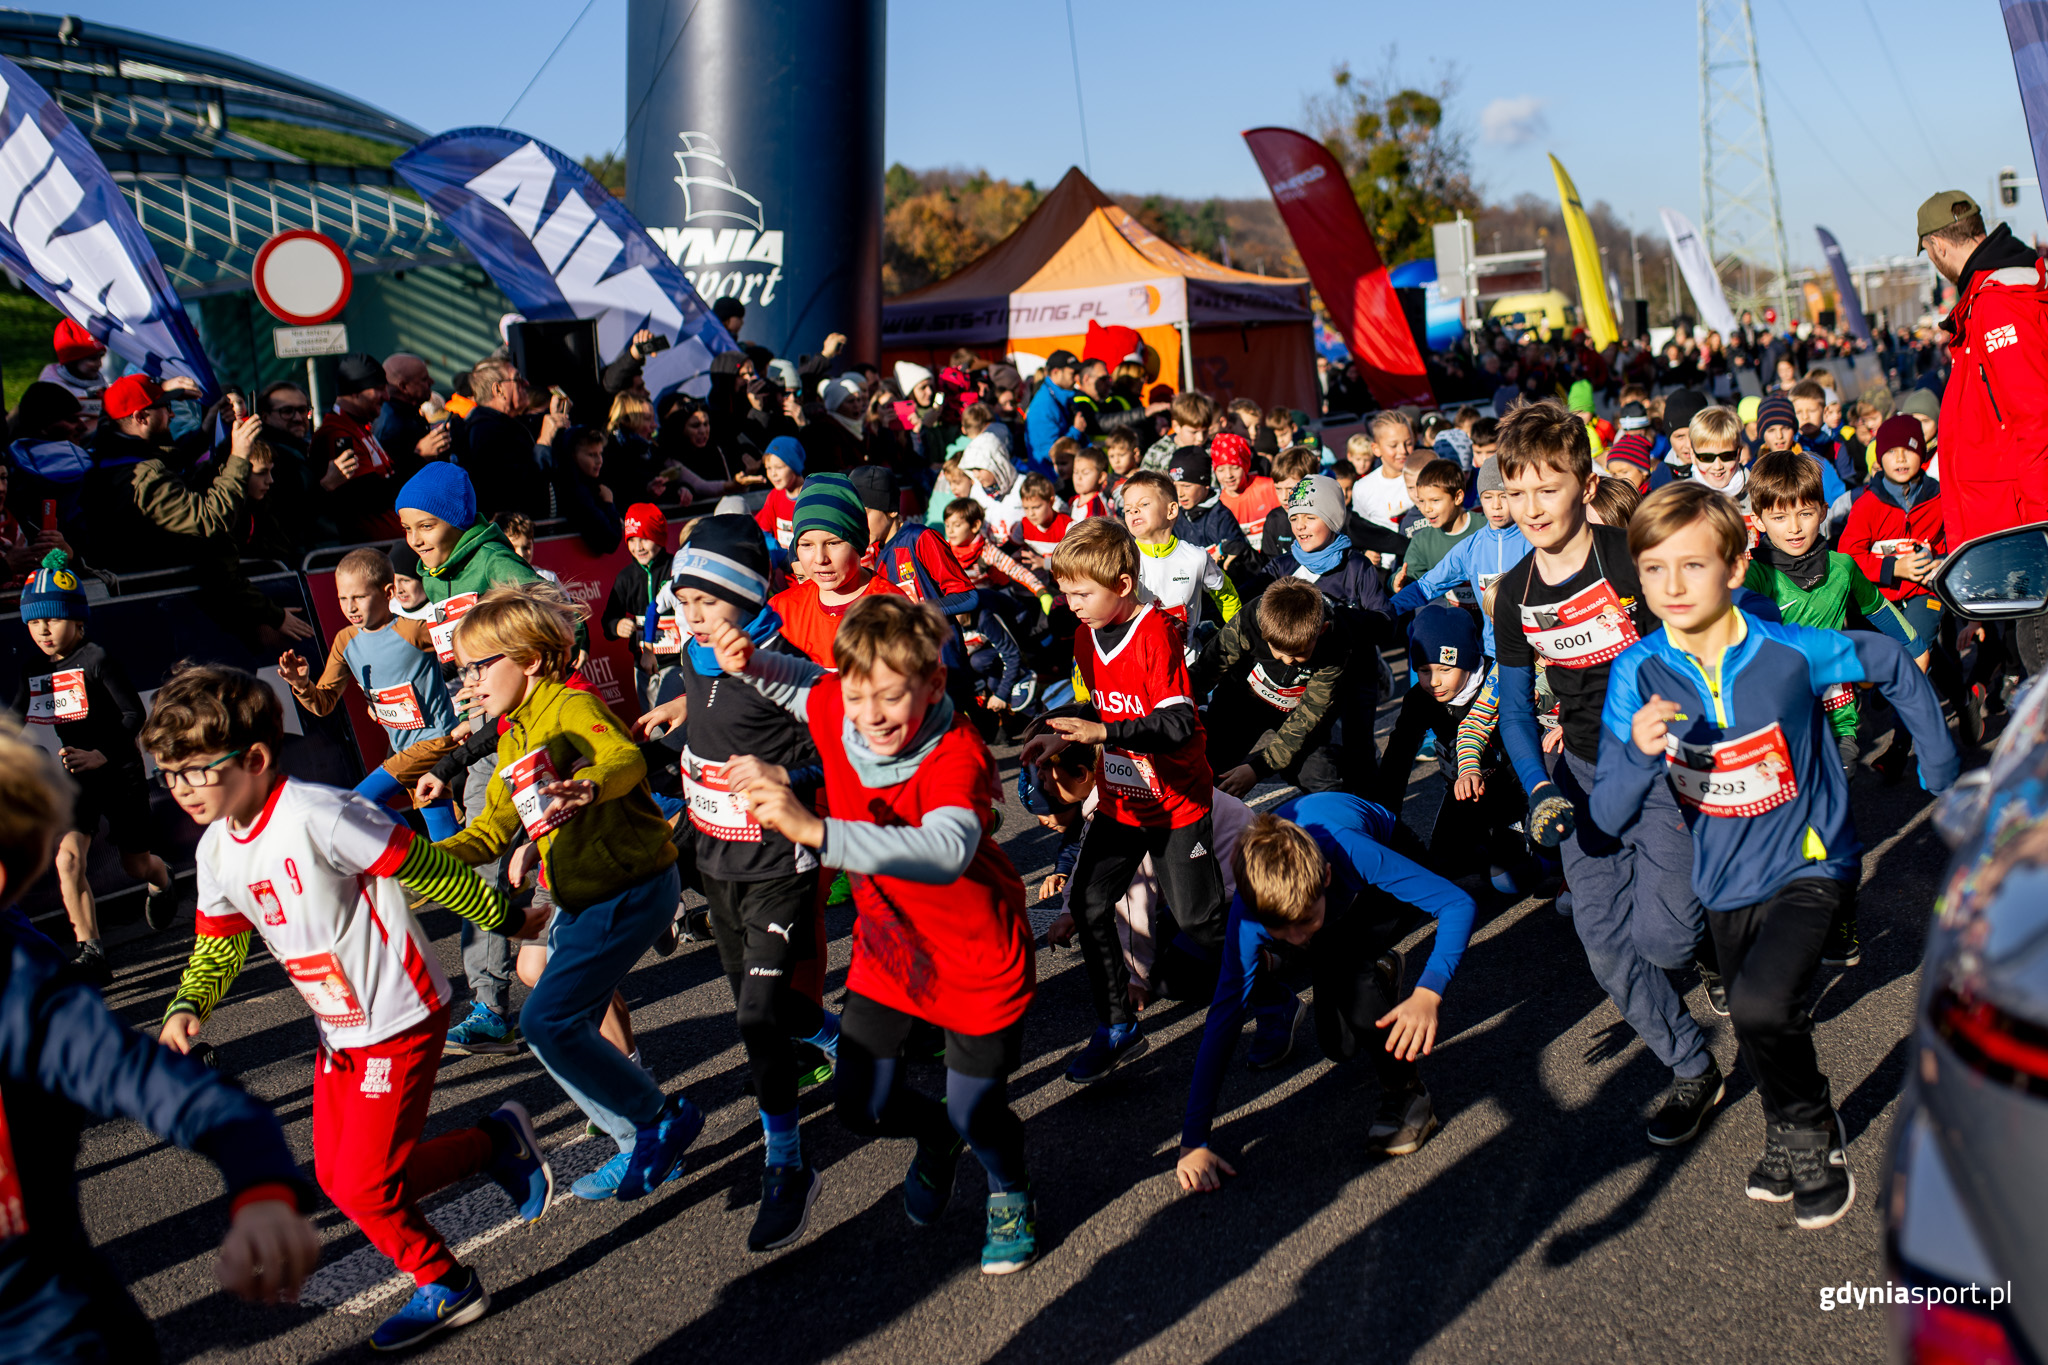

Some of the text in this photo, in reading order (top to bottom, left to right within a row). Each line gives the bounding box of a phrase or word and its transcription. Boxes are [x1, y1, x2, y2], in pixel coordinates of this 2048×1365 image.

[881, 302, 1109, 334] WW.STS-TIMING.PL
[690, 556, 709, 570] AP
[434, 634, 442, 646] M
[1535, 631, 1592, 652] S 6001
[582, 656, 613, 684] OFIT
[601, 686, 621, 699] ITNESS
[1261, 689, 1289, 705] 6046
[33, 697, 67, 711] S 6080
[1091, 689, 1146, 717] OLSKA
[1105, 761, 1133, 778] 6060
[1677, 774, 1746, 796] S 6293
[517, 795, 536, 818] 6097
[695, 794, 718, 814] 6315
[1189, 849, 1208, 859] adidas
[284, 857, 303, 896] 9
[364, 1067, 392, 1077] JEST
